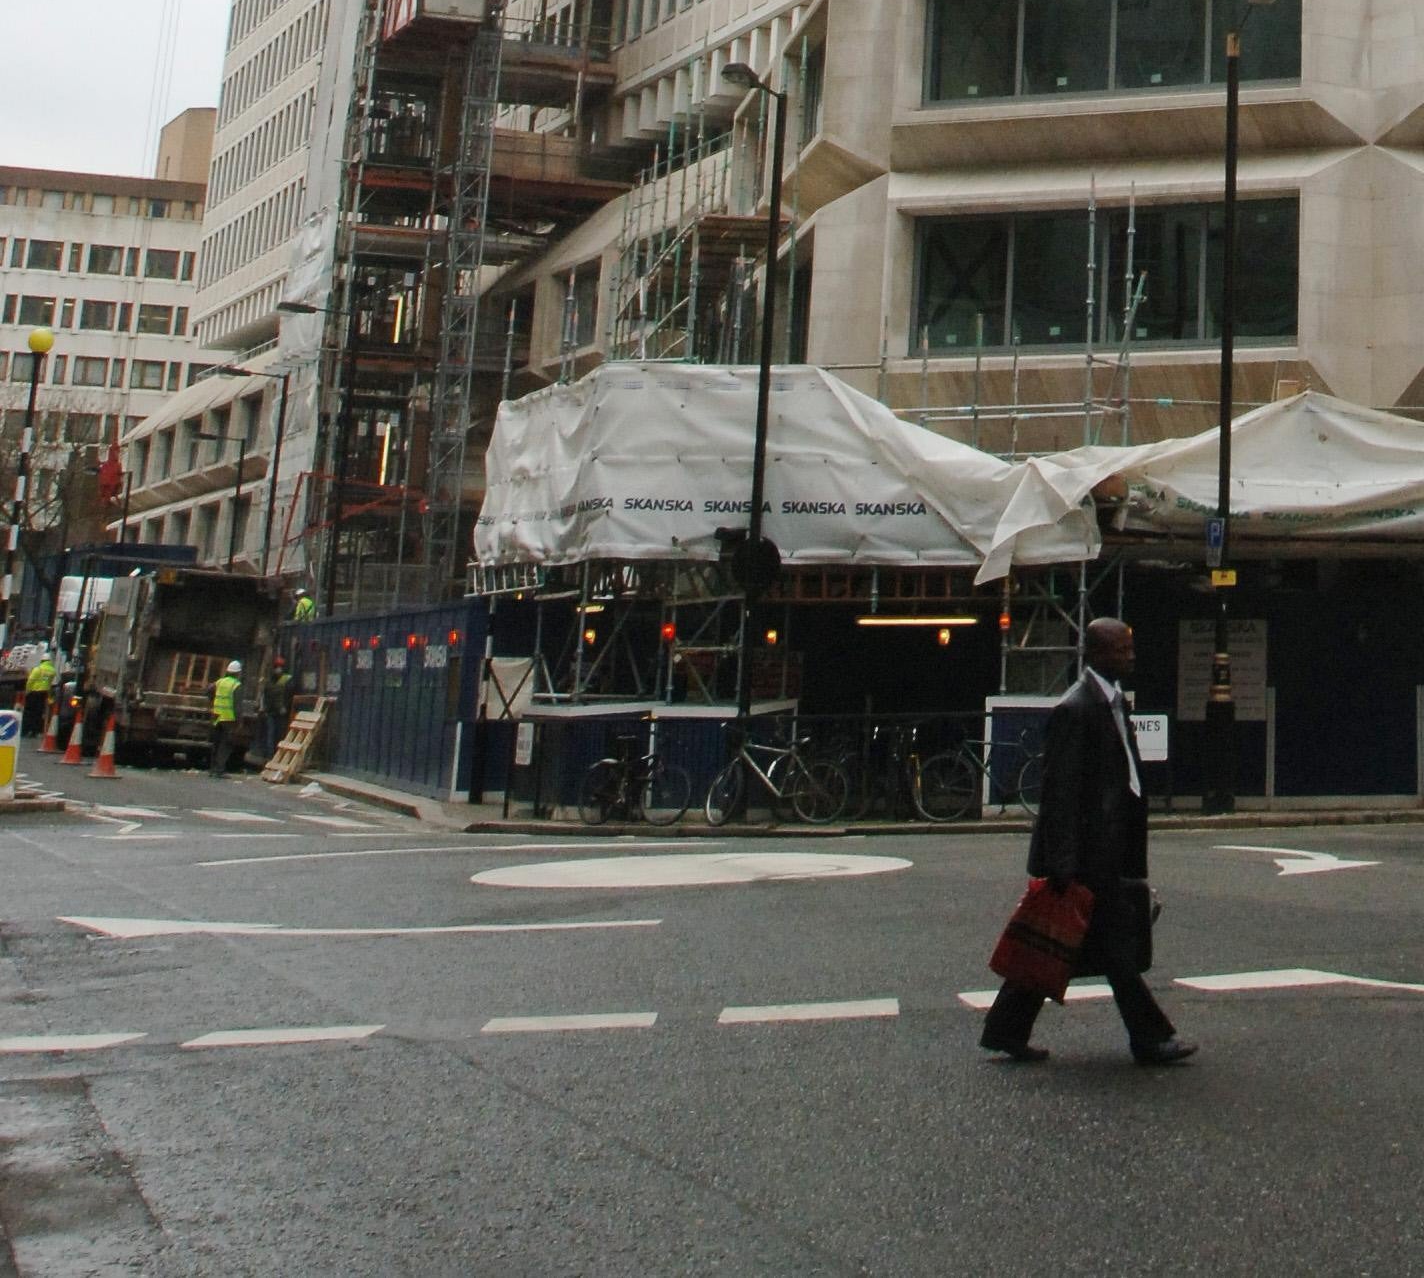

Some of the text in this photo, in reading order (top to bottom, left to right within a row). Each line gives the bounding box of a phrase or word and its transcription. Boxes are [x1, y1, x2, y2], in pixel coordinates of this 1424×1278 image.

[623, 497, 693, 512] SKANSKA
[704, 500, 772, 513] SKANSA
[782, 501, 846, 514] SKANSKA
[855, 502, 927, 516] SKANSKA
